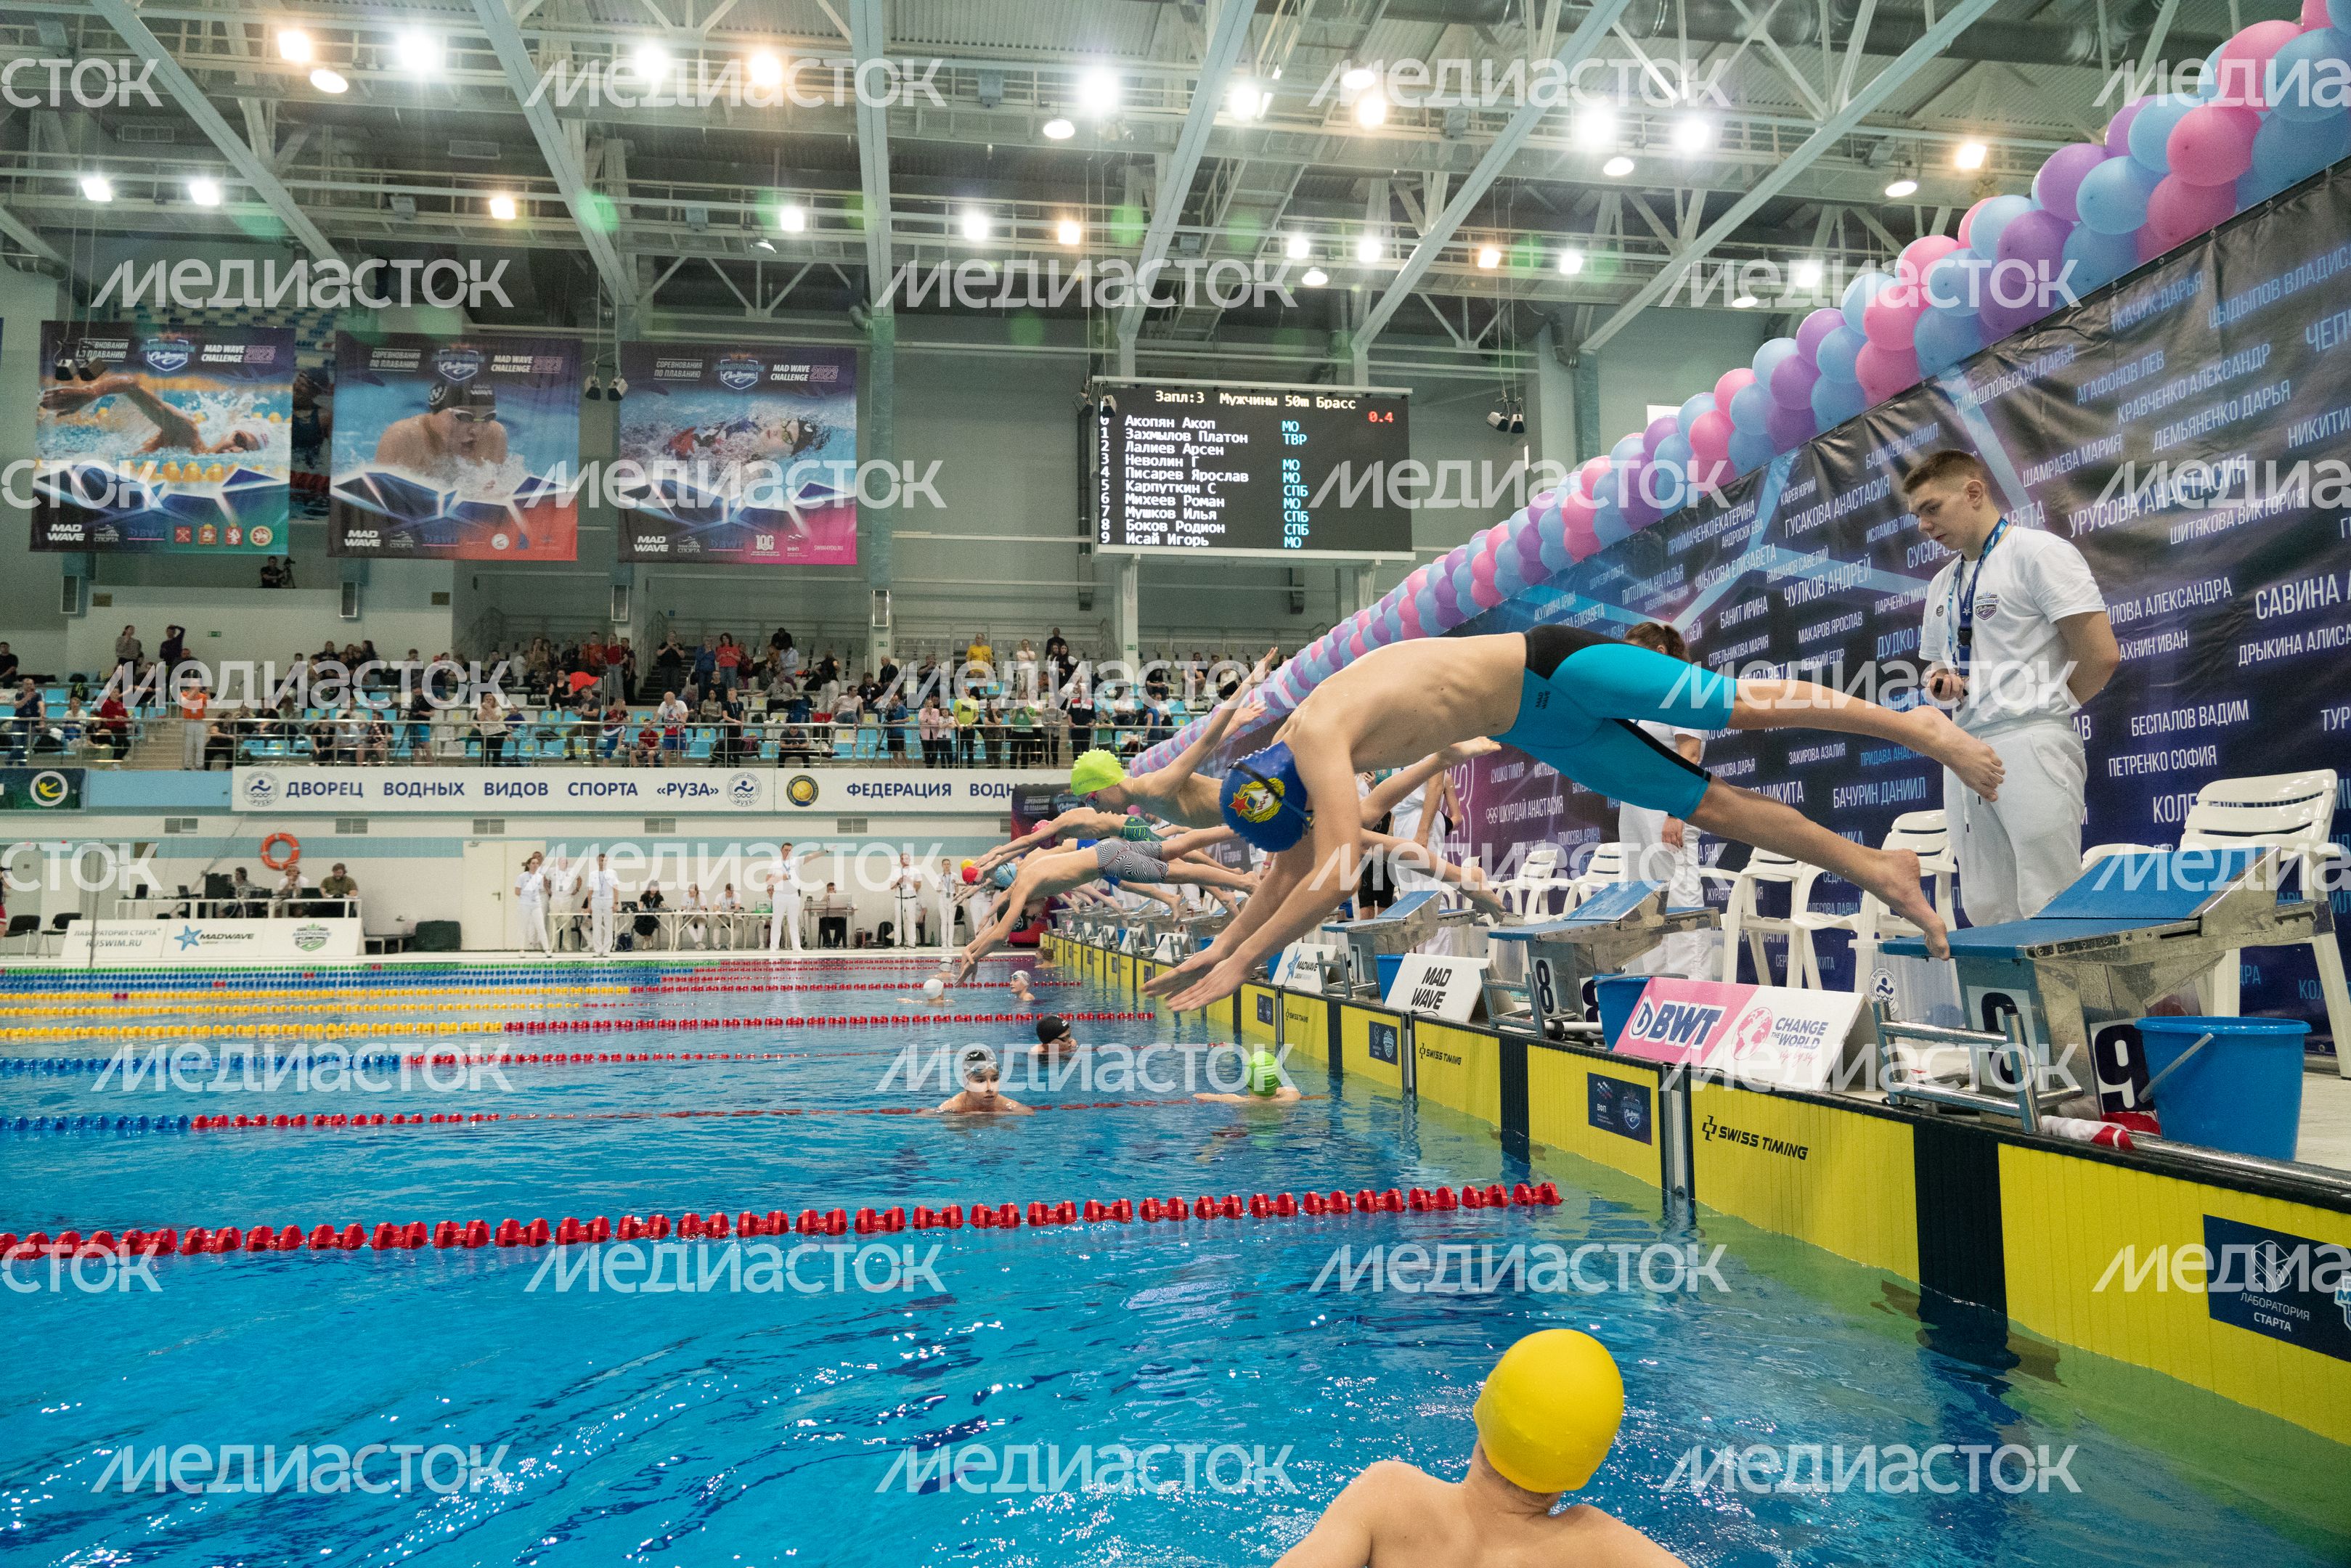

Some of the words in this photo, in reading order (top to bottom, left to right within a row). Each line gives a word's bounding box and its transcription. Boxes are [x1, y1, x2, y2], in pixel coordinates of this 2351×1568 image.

[2160, 271, 2204, 314] ДАРЬЯ
[2209, 278, 2281, 330] ЦЫДЫПОВ
[201, 354, 243, 362] CHALLENGE
[223, 345, 245, 354] WAVE
[2040, 344, 2074, 378] ДАРЬЯ
[664, 369, 701, 378] ПЛАВАНИЮ
[790, 364, 810, 373] WAVE
[810, 367, 839, 380] 2023
[2077, 358, 2138, 406] АГАФОНОВ
[2139, 350, 2165, 384] ЛЕВ
[2118, 383, 2187, 425] КРАВЧЕНКО
[2189, 343, 2270, 395] АЛЕКСАНДР
[1156, 391, 1205, 404] Запл:3
[1220, 393, 1277, 407] Мужчины
[1316, 397, 1356, 409] Брасс
[1125, 415, 1175, 428] Акопян
[1182, 417, 1215, 429] Акоп
[1282, 421, 1299, 432] МО
[1369, 412, 1393, 422] 0.4
[2153, 398, 2239, 453] ДЕМЬЯНЕНКО
[2243, 380, 2291, 417] ДАРЬЯ
[1101, 428, 1109, 438] 1
[1125, 428, 1191, 441] Захмылов
[1199, 430, 1248, 443] Платон
[1282, 433, 1307, 445] ТВР
[1101, 441, 1109, 452] 2
[1125, 441, 1175, 454] Лалиев
[1183, 444, 1224, 455] Арсен
[1865, 444, 1902, 470] БАДМАЕВ
[1904, 422, 1939, 454] ДАНИИЛ
[1101, 454, 1109, 465] 3
[1125, 454, 1183, 467] Неволин
[1191, 457, 1199, 467] Г
[1282, 460, 1300, 470] МО
[2023, 447, 2079, 488] ШАМРАЕВА
[2081, 433, 2122, 465] МАРИЯ
[1101, 467, 1110, 477] 4
[1126, 467, 1183, 481] Писарев
[1191, 469, 1249, 482] Ярослав
[1283, 473, 1300, 483] МО
[1101, 479, 1109, 490] 5
[1126, 481, 1200, 494] Карпуткин
[1207, 483, 1216, 494] С
[1284, 486, 1308, 497] СПБ
[1780, 487, 1798, 507] КАРЕВ
[1798, 476, 1816, 497] ЮРИЙ
[2068, 493, 2140, 538] УРУСОВА
[2144, 453, 2249, 515] АНАСТАСИЯ
[1101, 492, 1109, 504] 6
[1126, 494, 1176, 506] Михеев
[1183, 495, 1224, 507] Роман
[1284, 498, 1300, 509] МО
[1785, 502, 1831, 539] ГУСАКОВА
[1834, 474, 1890, 518] АНАСТАСИЯ
[1101, 505, 1110, 517] 7
[1126, 507, 1176, 519] Мушков
[1183, 508, 1217, 520] Илья
[1284, 511, 1309, 523] СПБ
[1715, 499, 1755, 534] ЕКАТЕРИНА
[1751, 518, 1764, 534] ЕВА
[2169, 513, 2235, 545] ШИТЯКОВА
[2238, 487, 2305, 526] ВИКТОРИЯ
[1101, 518, 1110, 530] 8
[1126, 519, 1168, 532] Боков
[1176, 520, 1225, 534] Родион
[1284, 524, 1309, 536] СПБ
[1866, 518, 1898, 544] ИСЛАМОВ
[1101, 531, 1110, 543] 9
[1126, 532, 1160, 544] Исай
[1168, 534, 1209, 547] Игорь
[1284, 537, 1302, 548] МО
[1732, 543, 1777, 578] ЕЛИЗАВЕТА
[1799, 545, 1829, 571] САВЕЛИЙ
[1654, 564, 1684, 590] НАТАЛЬЯ
[1784, 578, 1825, 608] ЧУЛКОВ
[1828, 553, 1872, 593] АНДРЕЙ
[1875, 591, 1909, 616] ЛАРЧЕНКО
[2146, 576, 2233, 617] АЛЕКСАНДРА
[2255, 573, 2341, 620] САВИНА
[1720, 605, 1743, 629] БАНИТ
[1744, 596, 1768, 621] ИРИНА
[1798, 621, 1830, 644] МАКАРОВ
[1831, 611, 1863, 634] ЯРОСЛАВ
[1708, 642, 1748, 666] СТРЕЛЬНИКОВА
[1749, 634, 1769, 654] МАРИЯ
[1877, 628, 1914, 661] ДУДКО
[2158, 630, 2188, 654] ИВАН
[2238, 633, 2303, 667] ДРЫКИНА
[1829, 648, 1845, 665] ЕГОР
[2131, 706, 2196, 737] БЕСПАЛОВ
[2199, 699, 2249, 727] ВАДИМ
[1789, 748, 1820, 765] ЗАКИРОВА
[1820, 743, 1846, 759] АЗАЛИЯ
[1861, 748, 1891, 767] ПРИДАВА
[2108, 751, 2168, 777] ПЕТРЕНКО
[2171, 745, 2217, 770] СОФИЯ
[1491, 764, 1507, 784] СУШКО
[1508, 761, 1524, 779] ТИМУР
[1737, 758, 1756, 776] ДАРЬЯ
[286, 781, 364, 798] ДВОРЕЦ
[383, 782, 465, 797] ВОДНЫХ
[484, 782, 549, 797] ВИДОВ
[568, 782, 639, 796] СПОРТА
[656, 782, 720, 799] «РУЗА»
[847, 783, 953, 799] ФЕДЕРАЦИЯ
[1833, 783, 1878, 809] БАЧУРИН
[1881, 777, 1926, 805] ДАНИИЛ
[1499, 799, 1525, 823] ШКУРДАЙ
[1528, 796, 1564, 820] АНАСТАСИЯ
[1584, 827, 1600, 845] АРИНА
[1295, 960, 1319, 971] MADWAVE
[1422, 966, 1452, 987] MAD
[1536, 959, 1555, 1014] 8
[1411, 988, 1446, 1010] WAVE
[1647, 1003, 1724, 1045] BWT
[1775, 1017, 1829, 1036] CHANGE
[1779, 1034, 1820, 1049] WORLD
[1426, 1049, 1442, 1060] SWISS
[1443, 1054, 1462, 1065] TIMING
[1719, 1126, 1758, 1148] SWISS
[1762, 1137, 1808, 1161] TIMING
[2240, 1292, 2310, 1321] ЛАБОРАТОРИЯ
[2254, 1312, 2291, 1332] СТАРТА
